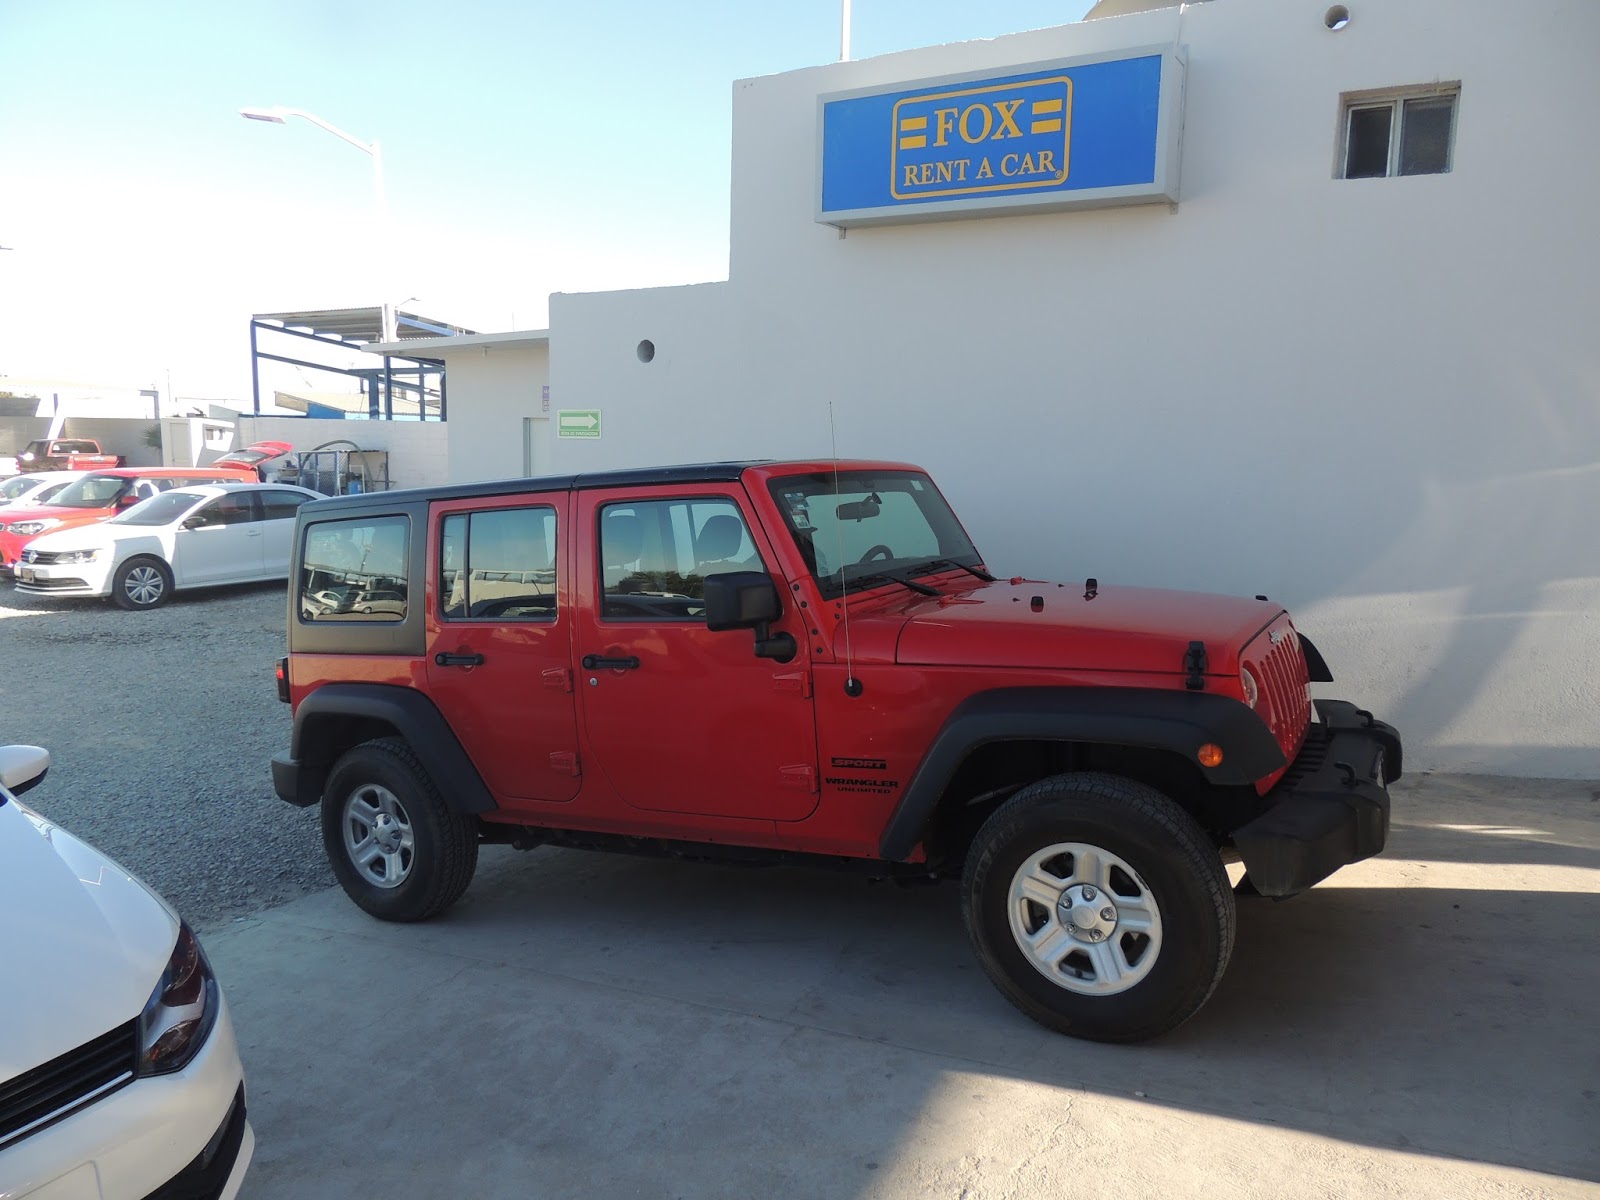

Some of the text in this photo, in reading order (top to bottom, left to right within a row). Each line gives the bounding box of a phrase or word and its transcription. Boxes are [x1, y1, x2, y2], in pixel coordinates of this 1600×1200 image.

[933, 98, 1025, 147] FOX
[903, 150, 1056, 187] RENT A CAR
[832, 758, 884, 768] SPORT
[825, 777, 898, 788] WRANGLER
